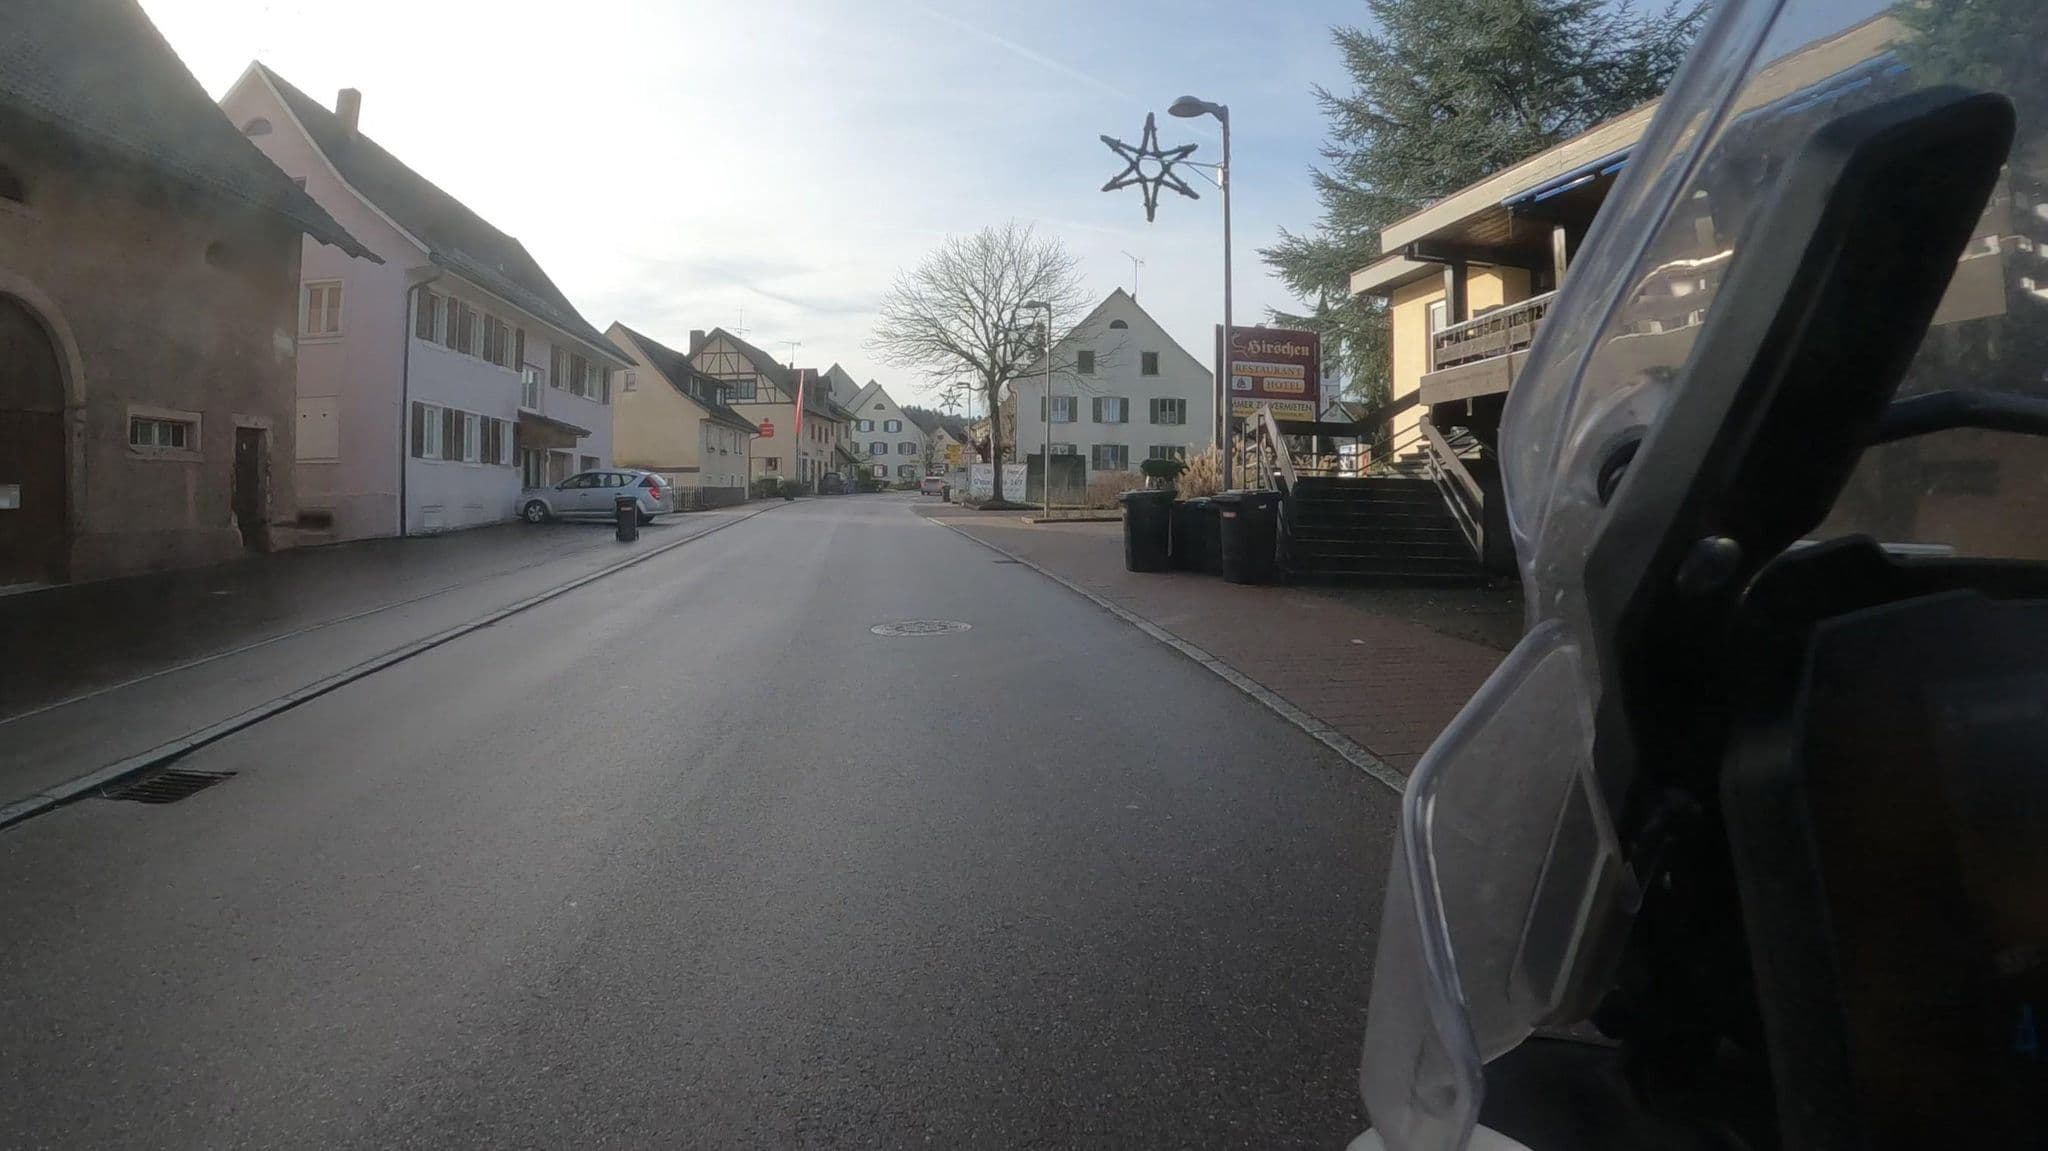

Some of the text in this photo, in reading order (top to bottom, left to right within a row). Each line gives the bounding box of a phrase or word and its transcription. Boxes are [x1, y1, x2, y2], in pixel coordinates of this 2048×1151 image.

[1247, 340, 1309, 359] Hirschen
[1235, 364, 1302, 376] RESTAURANT
[1265, 379, 1302, 391] HOTEL
